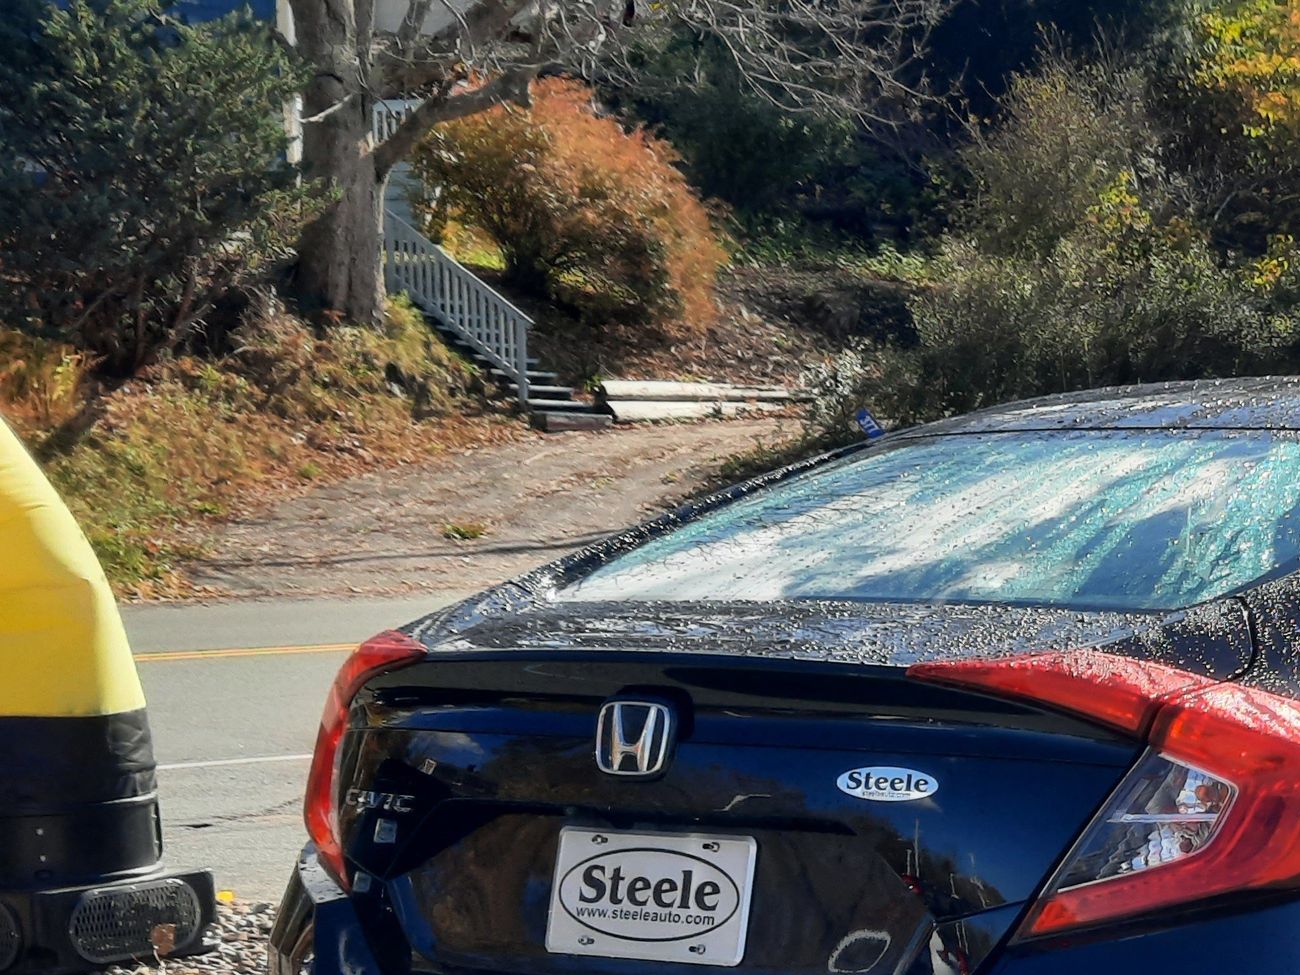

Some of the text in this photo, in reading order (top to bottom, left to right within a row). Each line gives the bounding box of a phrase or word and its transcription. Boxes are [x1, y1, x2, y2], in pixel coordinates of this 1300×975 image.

[846, 771, 929, 793] Steele
[578, 864, 721, 912] Steele
[575, 906, 715, 926] www.steeleauto.com
